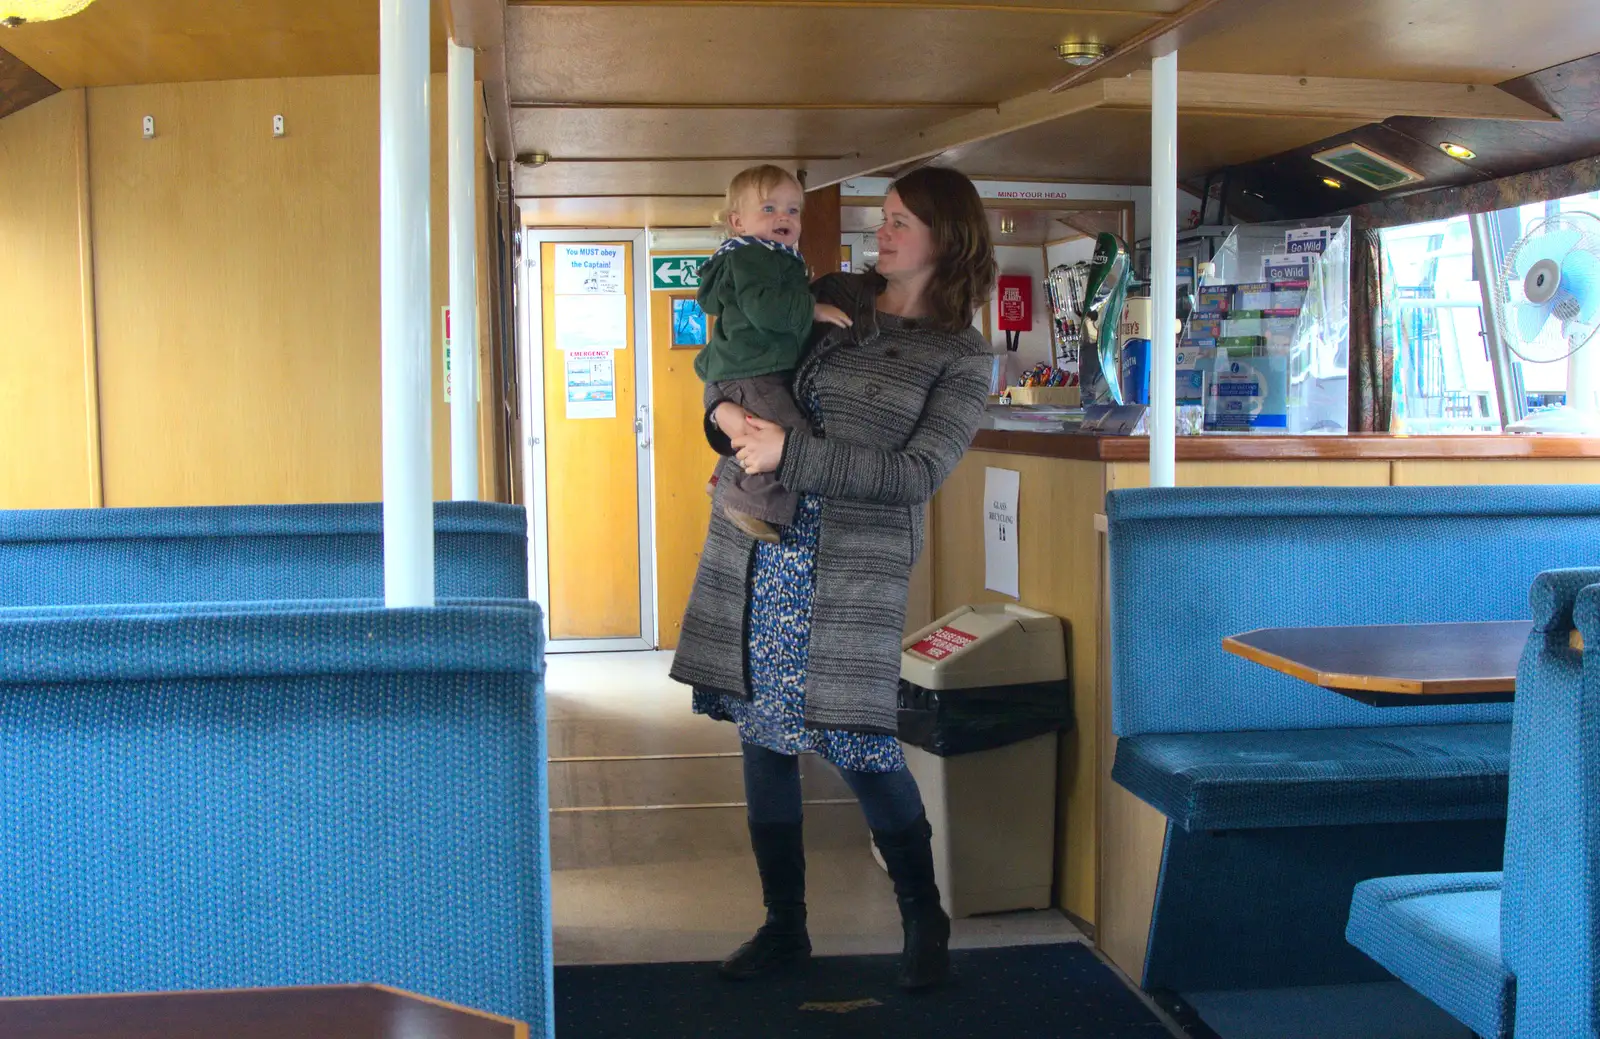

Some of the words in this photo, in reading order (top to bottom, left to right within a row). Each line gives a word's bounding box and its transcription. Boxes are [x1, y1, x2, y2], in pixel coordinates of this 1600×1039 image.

[1291, 242, 1302, 252] Go
[1303, 240, 1320, 252] Wild
[600, 248, 616, 258] obey
[584, 260, 611, 269] Captain!
[1270, 268, 1283, 278] Go
[1284, 267, 1304, 277] Wild
[993, 501, 1007, 511] GLASS
[989, 512, 1014, 525] RECYCLING
